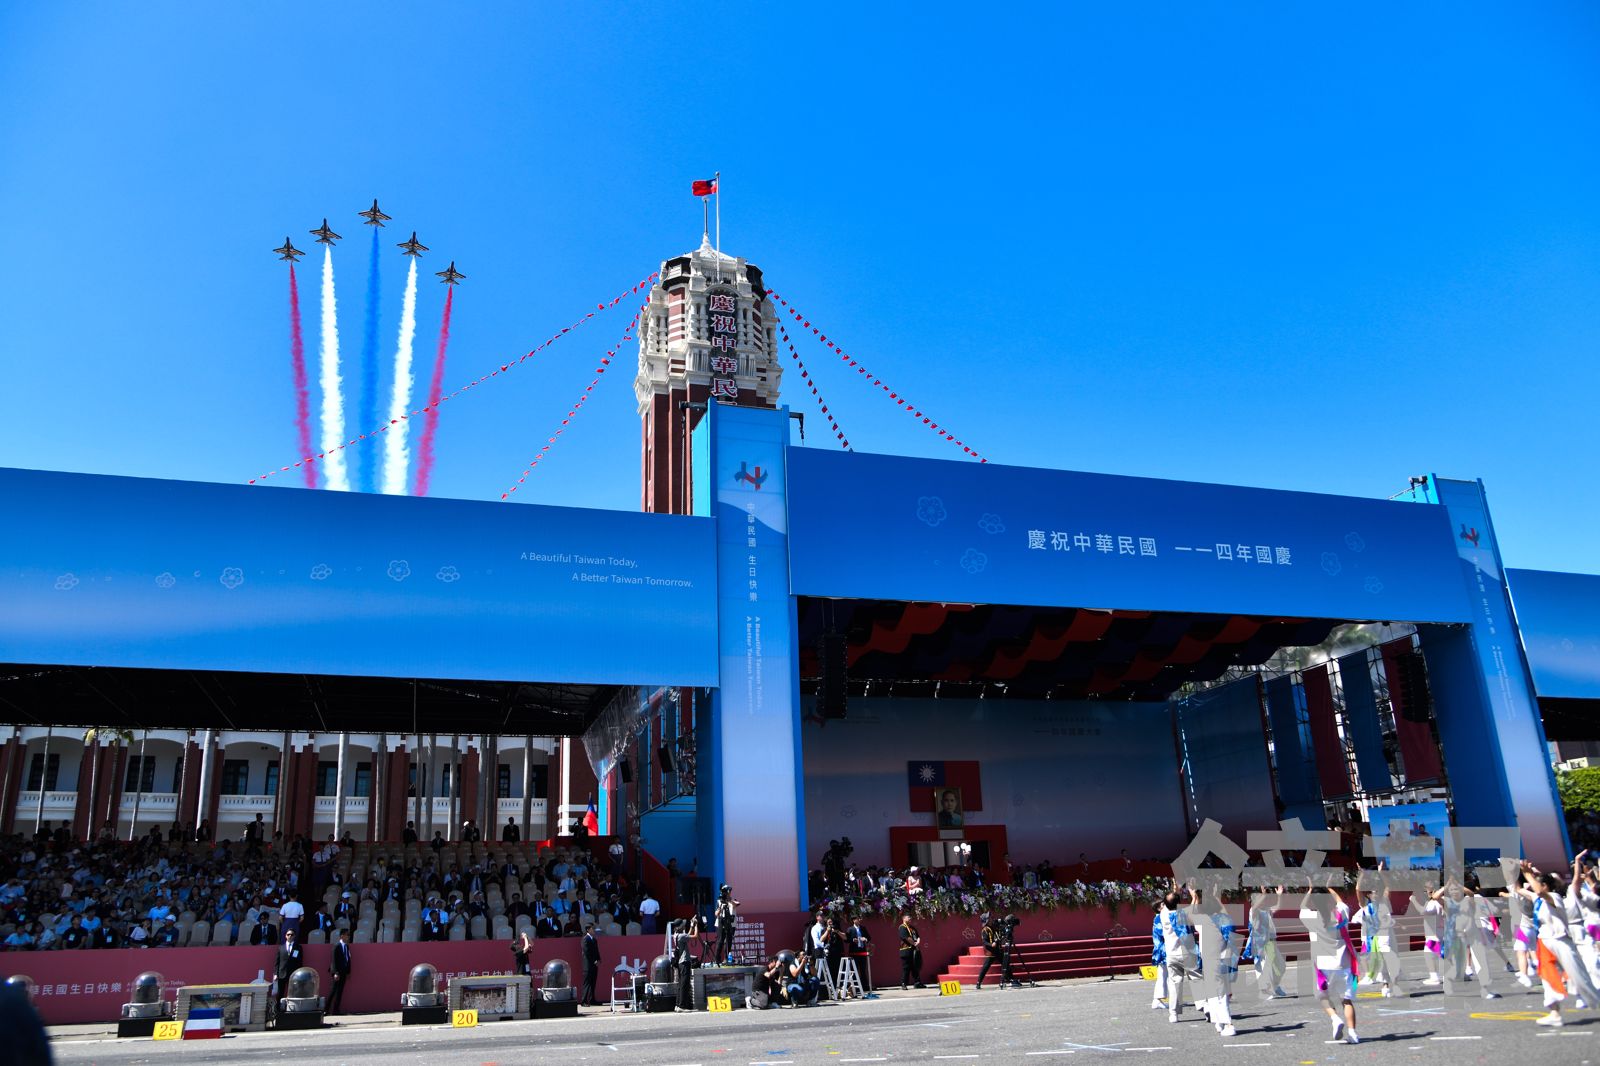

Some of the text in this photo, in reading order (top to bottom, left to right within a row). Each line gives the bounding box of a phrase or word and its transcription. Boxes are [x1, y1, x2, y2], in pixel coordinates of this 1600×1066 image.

[710, 294, 738, 405] 慶祝中華民
[1028, 529, 1292, 565] 慶祝中華民國 一一四年國慶
[520, 552, 638, 568] A Beautiful Taiwan Today,
[572, 573, 694, 588] A Better Taiwan Tomorrow.
[1147, 967, 1154, 978] 5
[944, 982, 957, 994] 10
[713, 999, 728, 1010] 15
[457, 1012, 474, 1025] 20
[159, 1023, 178, 1037] 25
